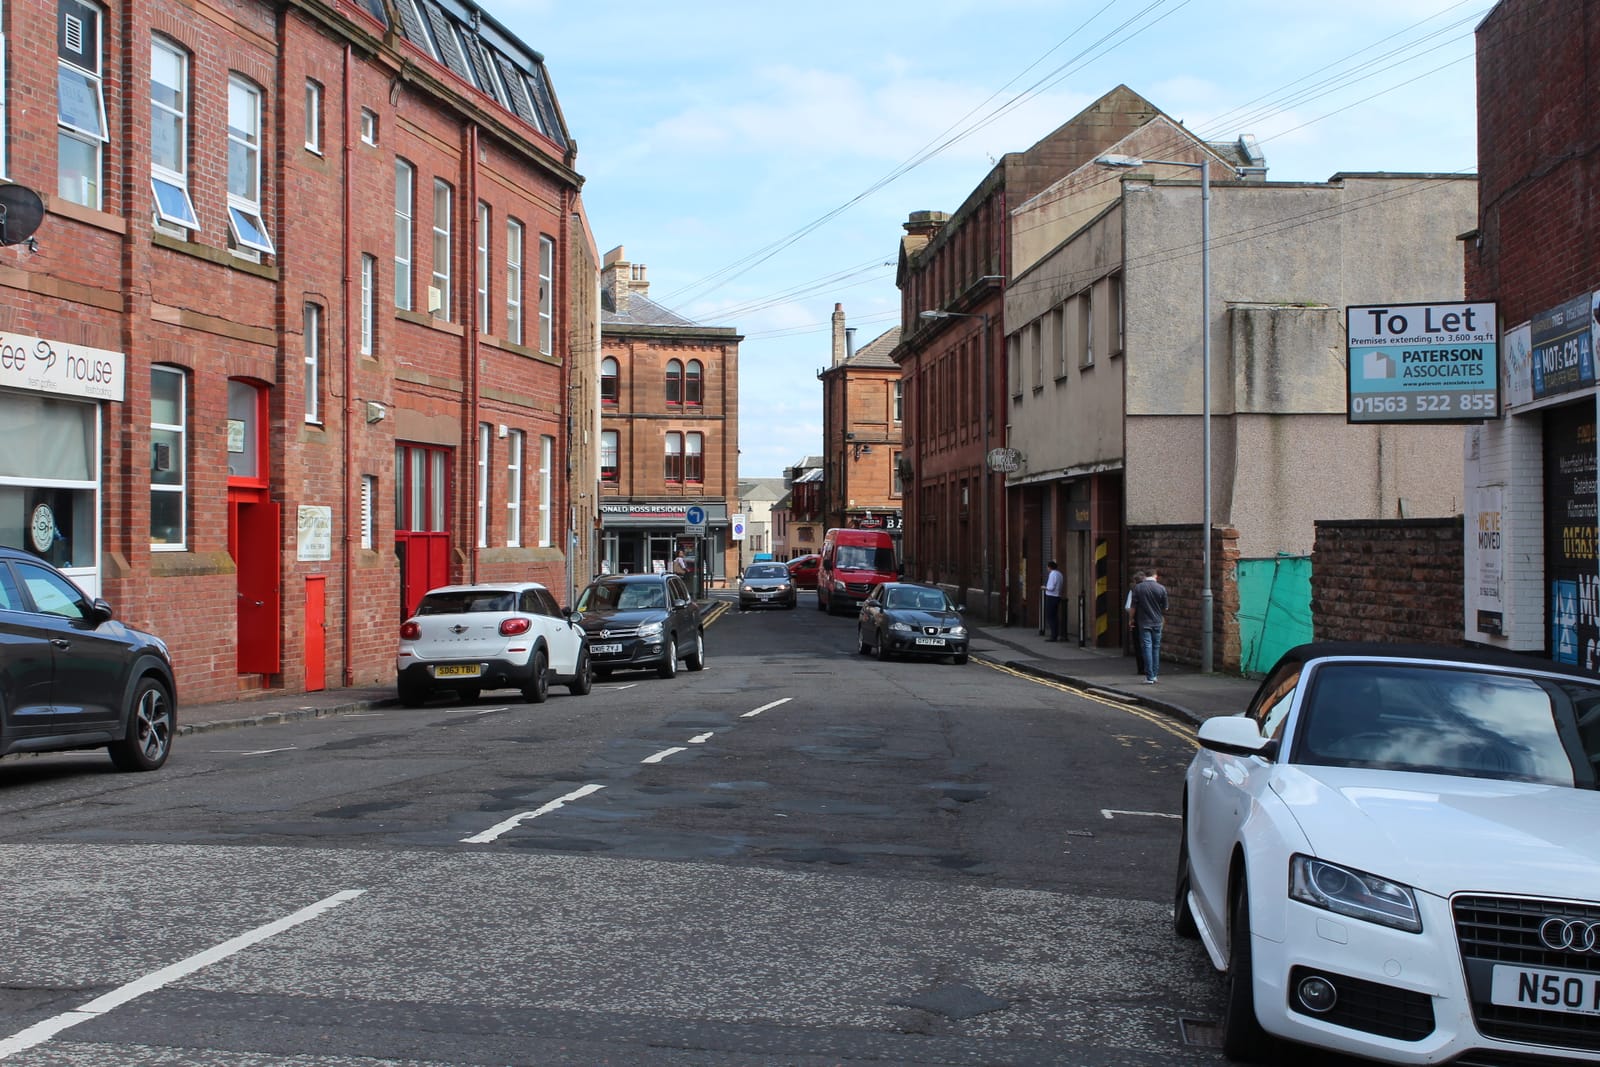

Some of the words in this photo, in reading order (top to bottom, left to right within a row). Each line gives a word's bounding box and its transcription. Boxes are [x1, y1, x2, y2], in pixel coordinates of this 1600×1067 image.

[1367, 309, 1408, 335] To
[1424, 307, 1477, 333] Let
[1351, 337, 1387, 345] Premises
[1390, 335, 1432, 344] extending
[1447, 334, 1471, 342] 3,600
[1473, 332, 1494, 342] sq.ft
[0, 337, 26, 371] ee
[66, 349, 112, 383] house
[1402, 348, 1483, 363] PATERSON
[1542, 346, 1563, 373] MOTs
[1564, 338, 1579, 368] £25
[1402, 363, 1484, 378] ASSOCIATES
[1352, 395, 1408, 413] 01563
[1416, 395, 1451, 411] 522
[1459, 393, 1495, 411] 855
[629, 505, 650, 513] ROSS
[1477, 511, 1501, 531] WE'VE
[1477, 532, 1501, 550] MOVED
[1518, 972, 1583, 1007] N50
